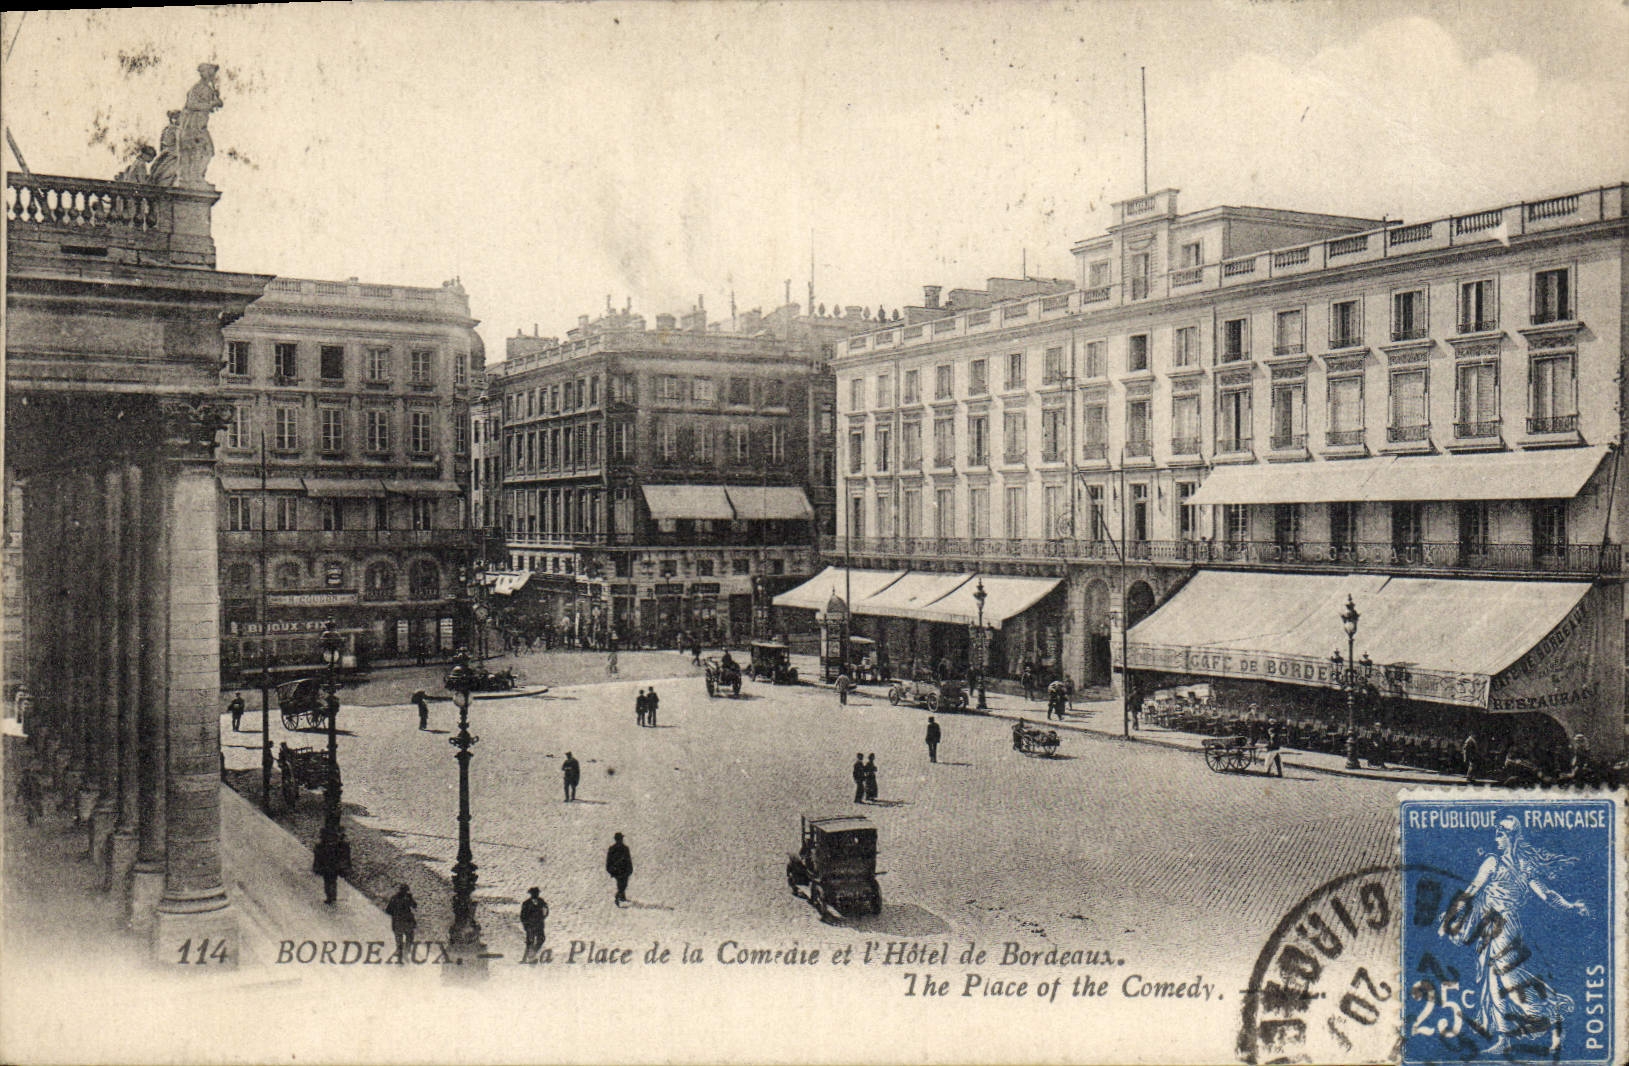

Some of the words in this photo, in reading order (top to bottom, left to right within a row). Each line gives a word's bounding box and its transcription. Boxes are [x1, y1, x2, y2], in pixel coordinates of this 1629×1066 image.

[1240, 659, 1258, 673] DE
[1524, 809, 1605, 830] FRANÇAISE
[1585, 963, 1605, 1050] POSTES
